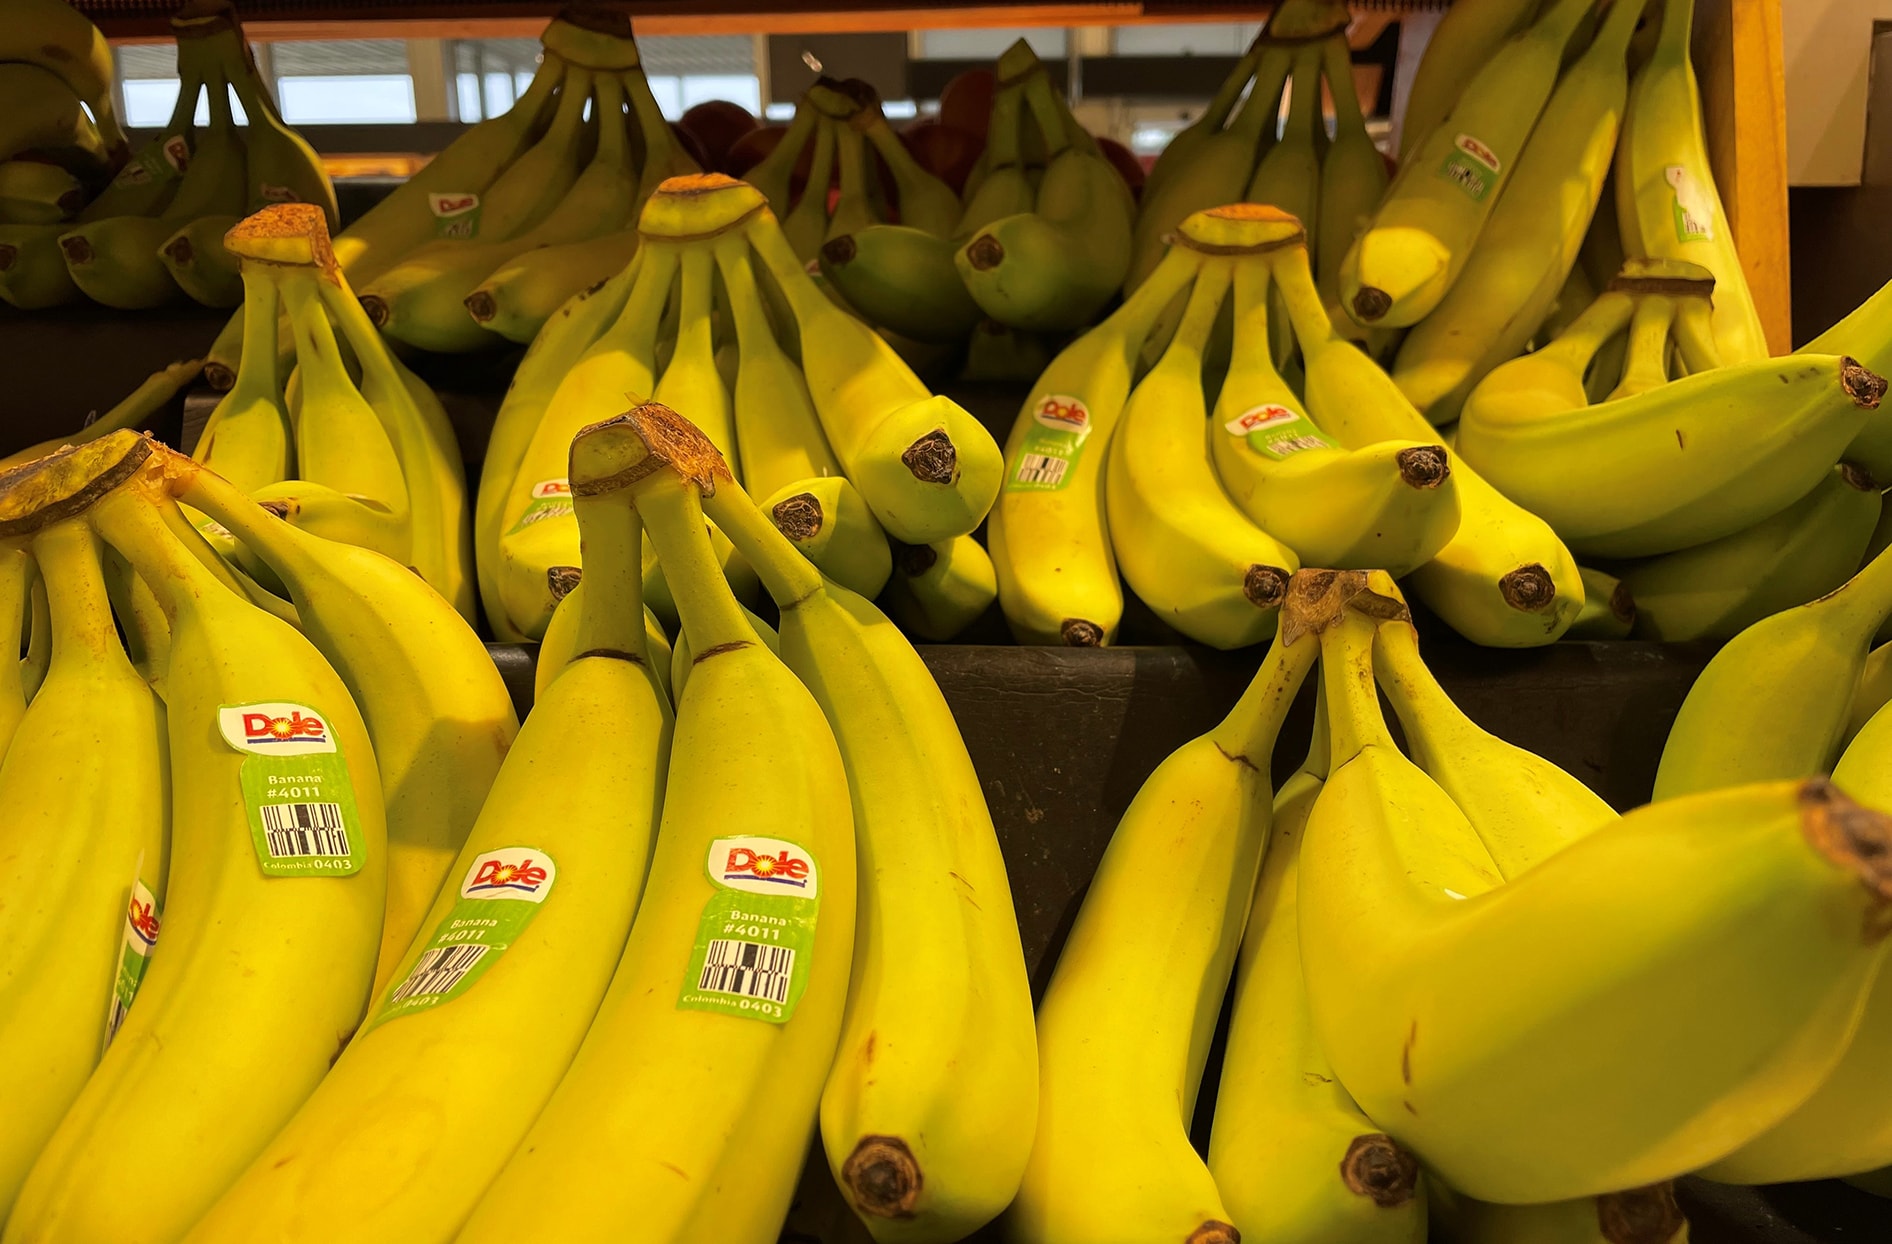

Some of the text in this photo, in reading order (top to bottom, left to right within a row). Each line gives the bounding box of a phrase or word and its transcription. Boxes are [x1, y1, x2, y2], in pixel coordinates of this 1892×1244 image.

[1042, 401, 1085, 423] Dole
[1240, 407, 1288, 429] Dole
[242, 711, 325, 740] Dole
[268, 775, 322, 785] Banana
[267, 786, 320, 799] #4011
[264, 859, 352, 870] Colombia 0403
[471, 859, 547, 887] Dole
[725, 848, 810, 879] Dole
[129, 897, 160, 940] ole
[450, 919, 499, 930] Banana
[730, 910, 787, 927] Banana
[438, 929, 486, 944] #4011
[723, 923, 780, 941] #4011
[683, 994, 782, 1018] Colombia 0403
